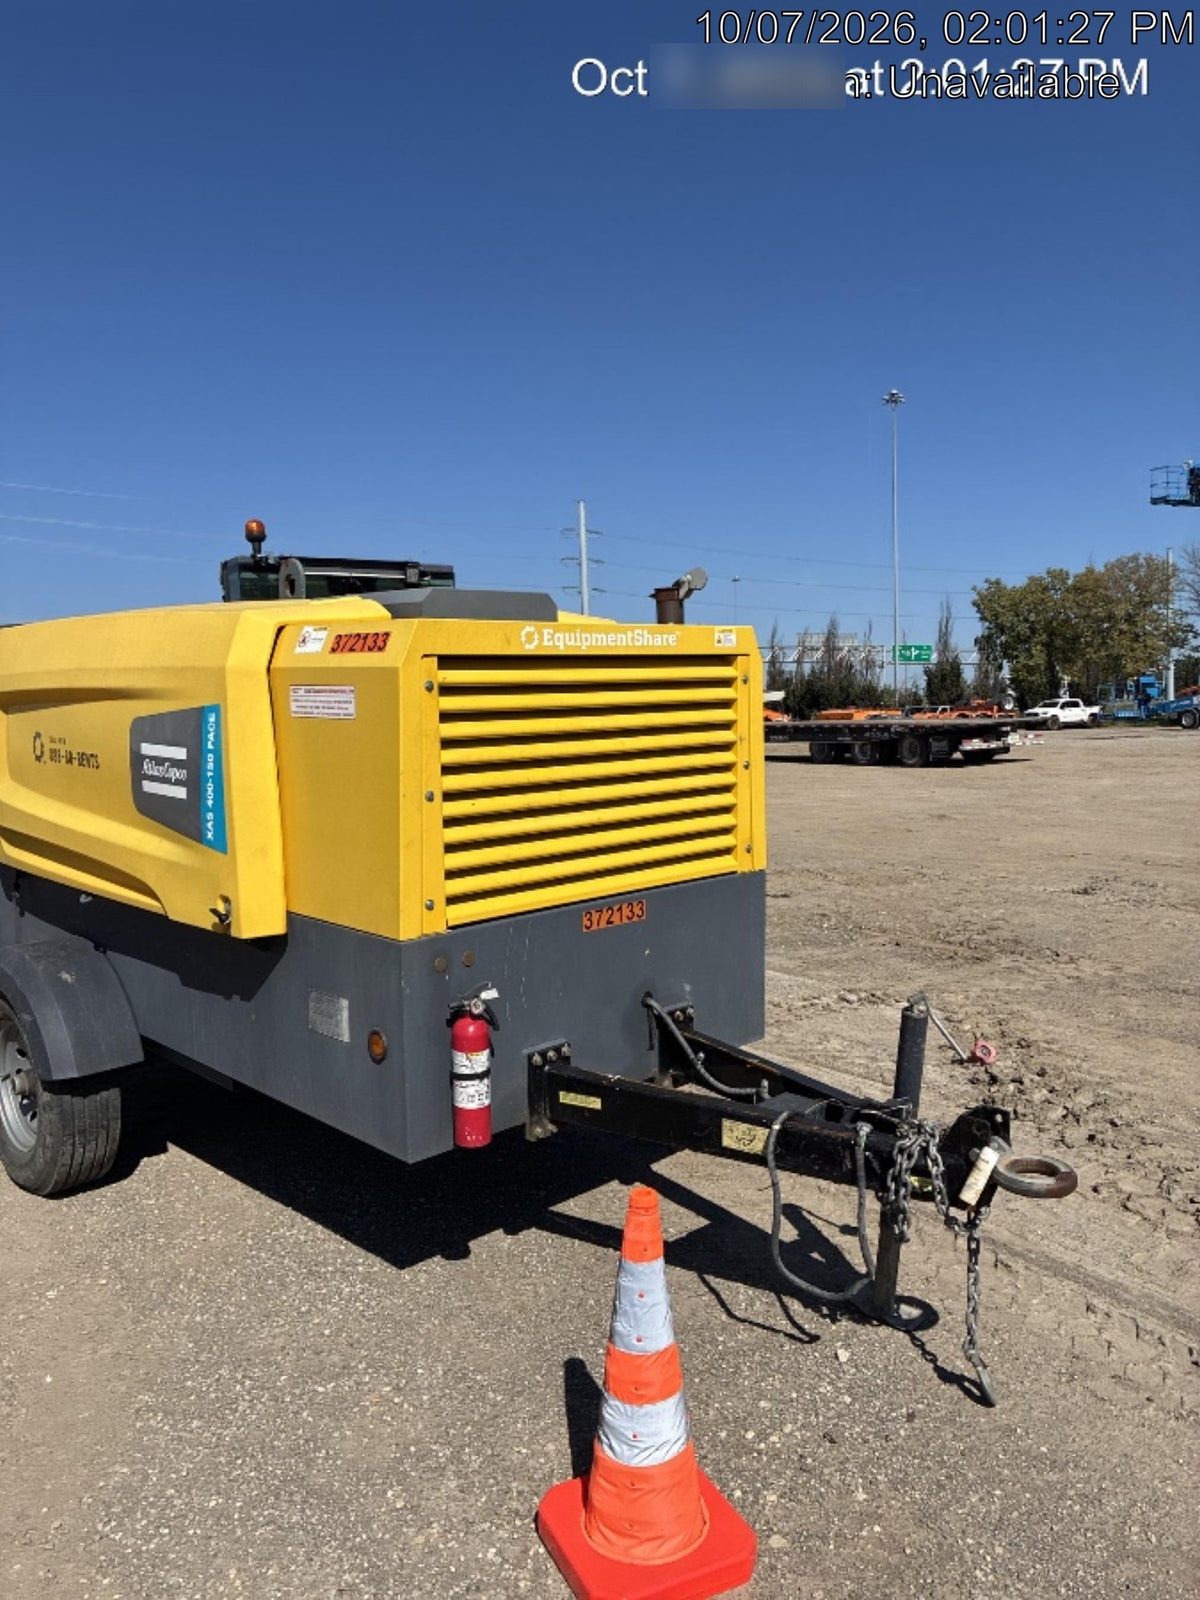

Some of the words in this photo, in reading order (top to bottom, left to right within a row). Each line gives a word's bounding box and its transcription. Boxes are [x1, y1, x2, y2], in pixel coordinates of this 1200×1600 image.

[330, 632, 391, 653] 372133
[542, 628, 679, 650] EquipmentShare
[583, 900, 646, 931] 372133
